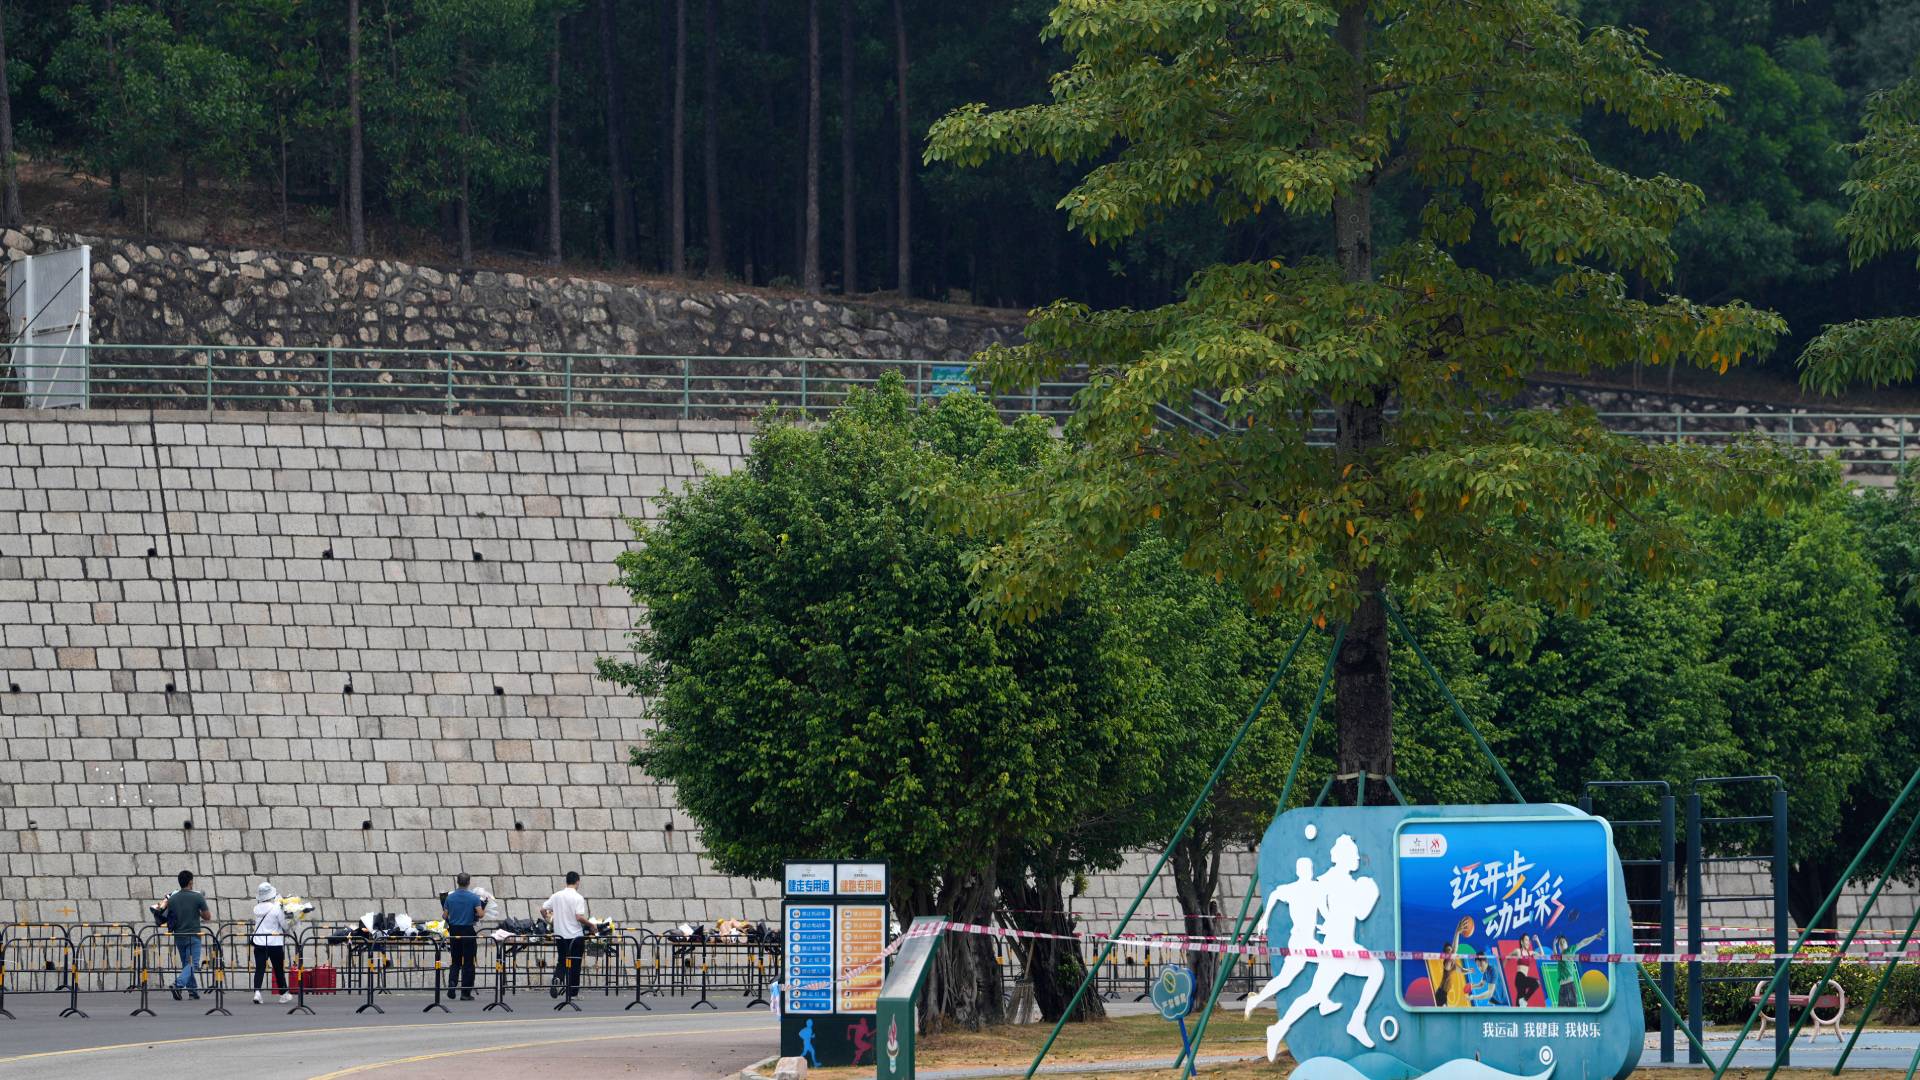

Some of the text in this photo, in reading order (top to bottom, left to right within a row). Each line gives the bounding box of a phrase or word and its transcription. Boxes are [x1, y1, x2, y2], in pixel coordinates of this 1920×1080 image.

[788, 879, 830, 892] 健走专用道
[1449, 849, 1536, 910] 迈开步
[1482, 869, 1565, 939] 动出彩
[1482, 1021, 1601, 1038] 我运动 我健康 我快乐
